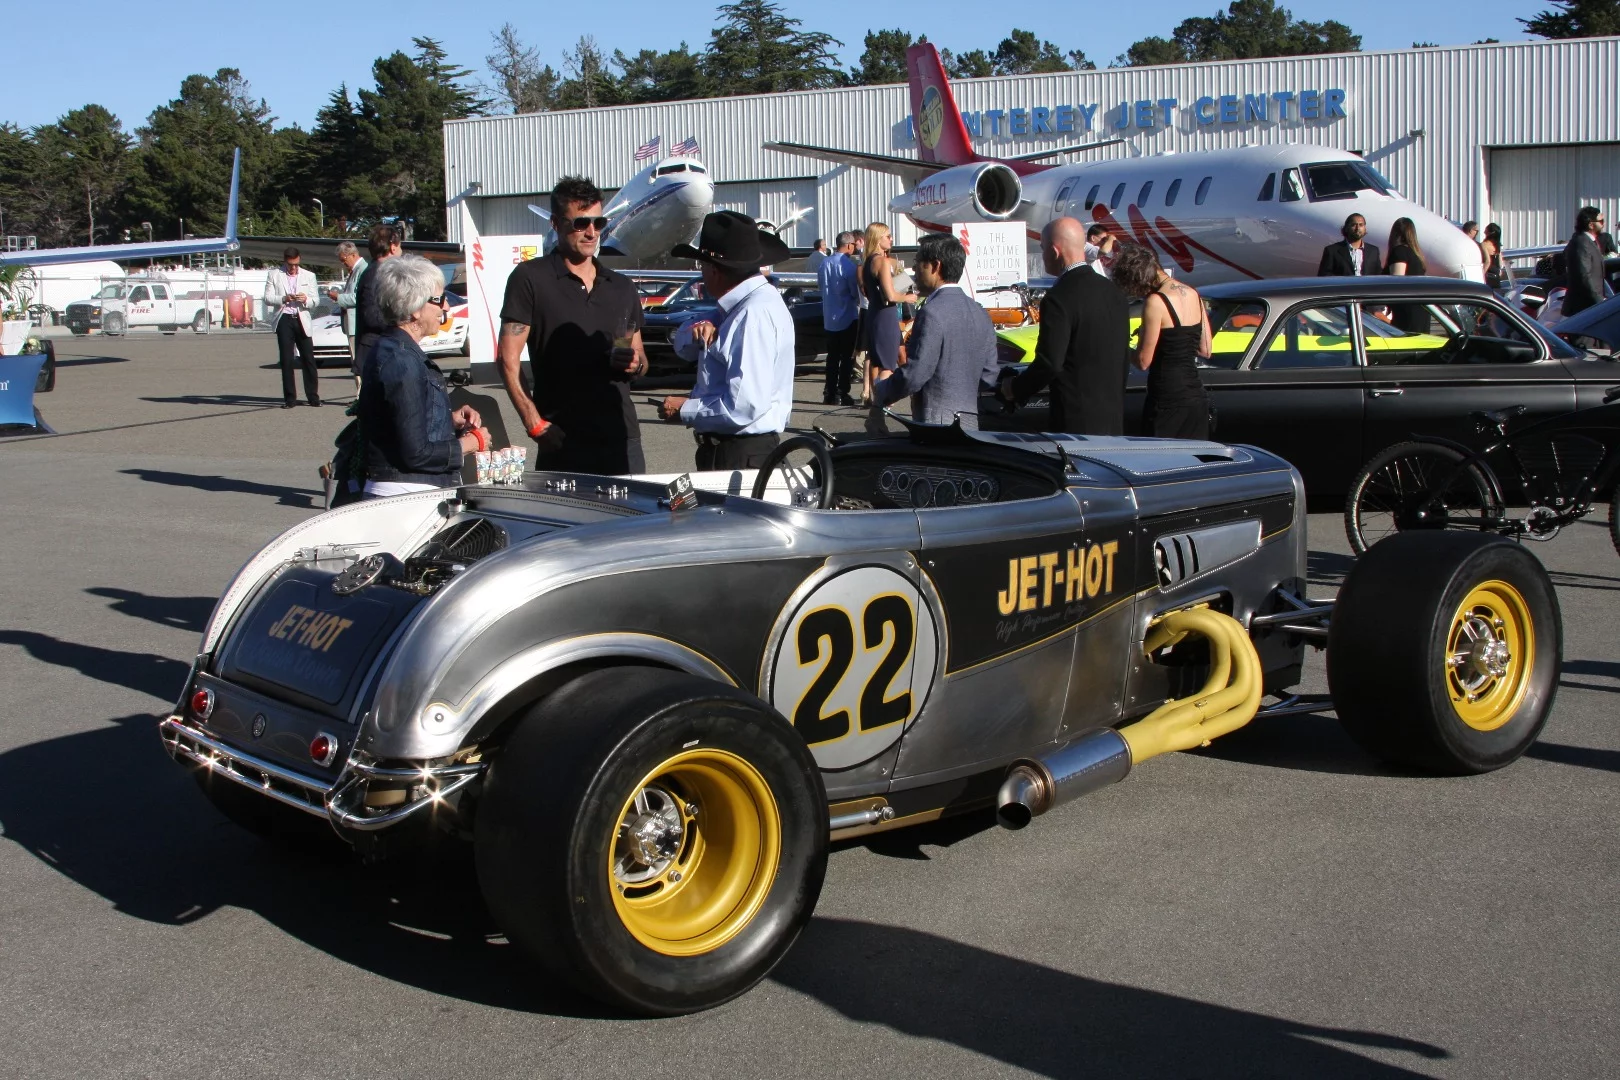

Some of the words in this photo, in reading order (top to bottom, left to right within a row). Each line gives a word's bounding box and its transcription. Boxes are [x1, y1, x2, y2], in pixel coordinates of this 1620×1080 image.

[906, 103, 1098, 141] NTEREY
[1115, 98, 1178, 130] JET
[1194, 88, 1348, 125] CENTER
[976, 245, 1020, 256] DAYTIME
[989, 232, 1006, 243] THE
[976, 257, 1020, 269] AUCTION
[997, 539, 1119, 616] JET-HOT
[268, 604, 354, 652] JET-HOT
[995, 617, 1018, 643] High
[791, 591, 916, 748] 22
